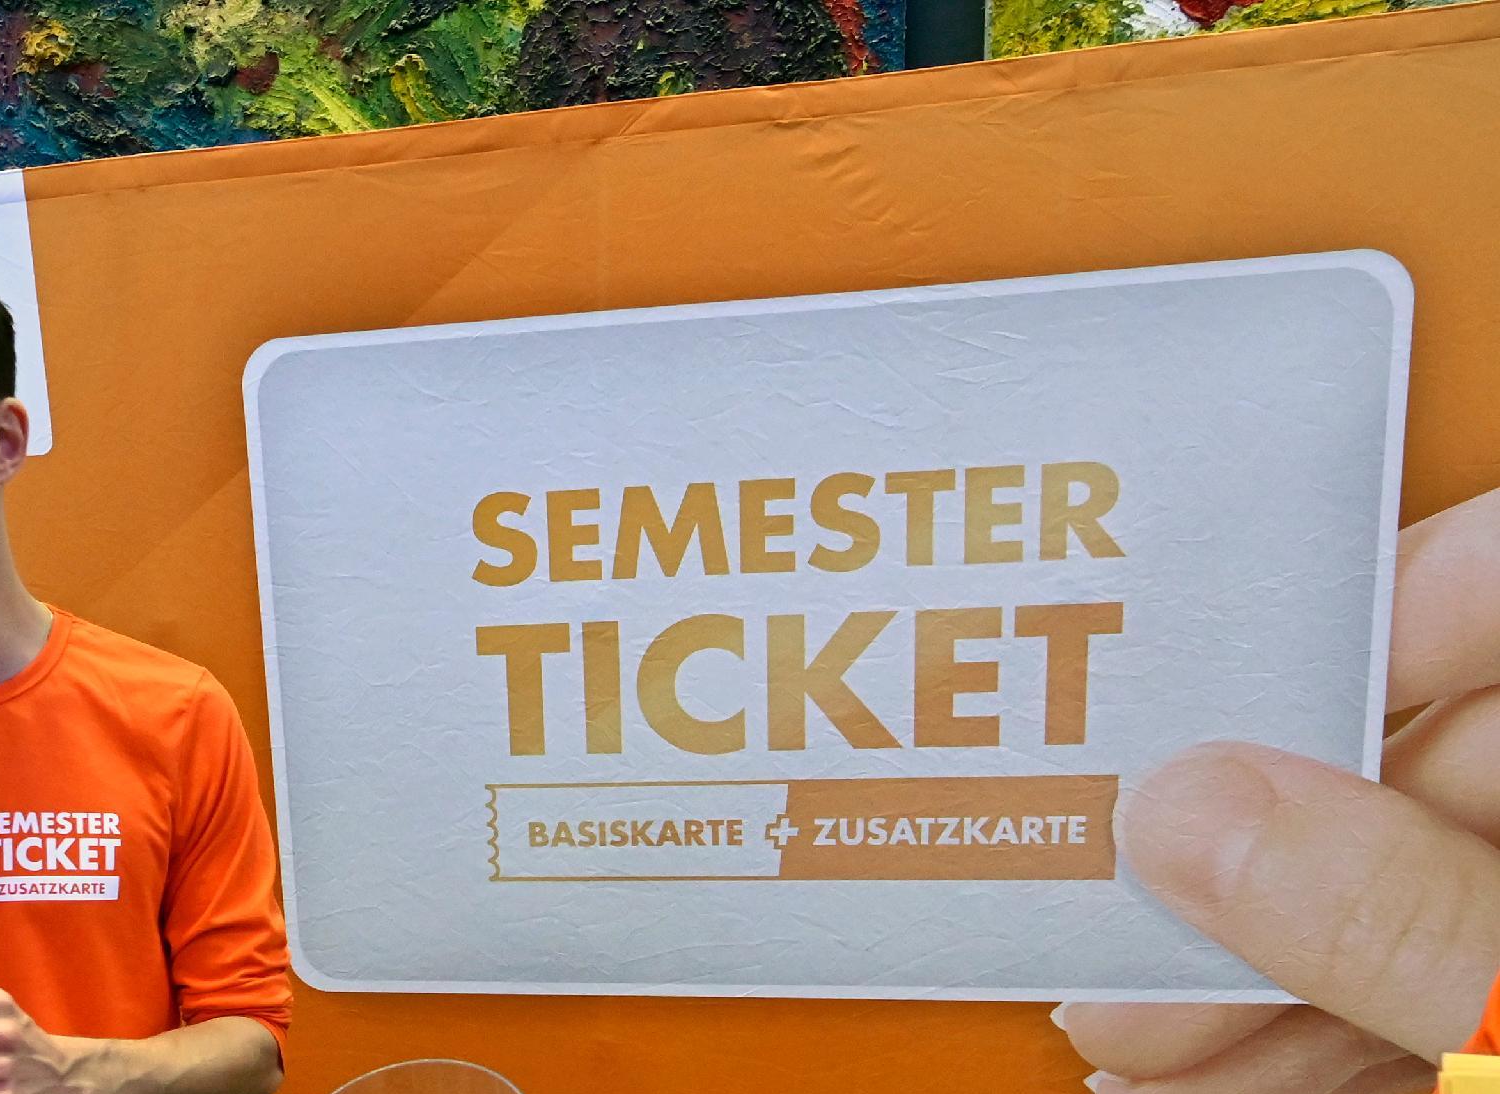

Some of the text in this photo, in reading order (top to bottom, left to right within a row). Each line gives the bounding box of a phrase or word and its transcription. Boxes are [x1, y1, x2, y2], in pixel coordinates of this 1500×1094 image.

[471, 461, 1127, 587] SEMESTER
[475, 602, 1124, 757] TICKET
[526, 818, 744, 848] BASISKARTE
[813, 815, 1087, 846] ZUSATZKARTE
